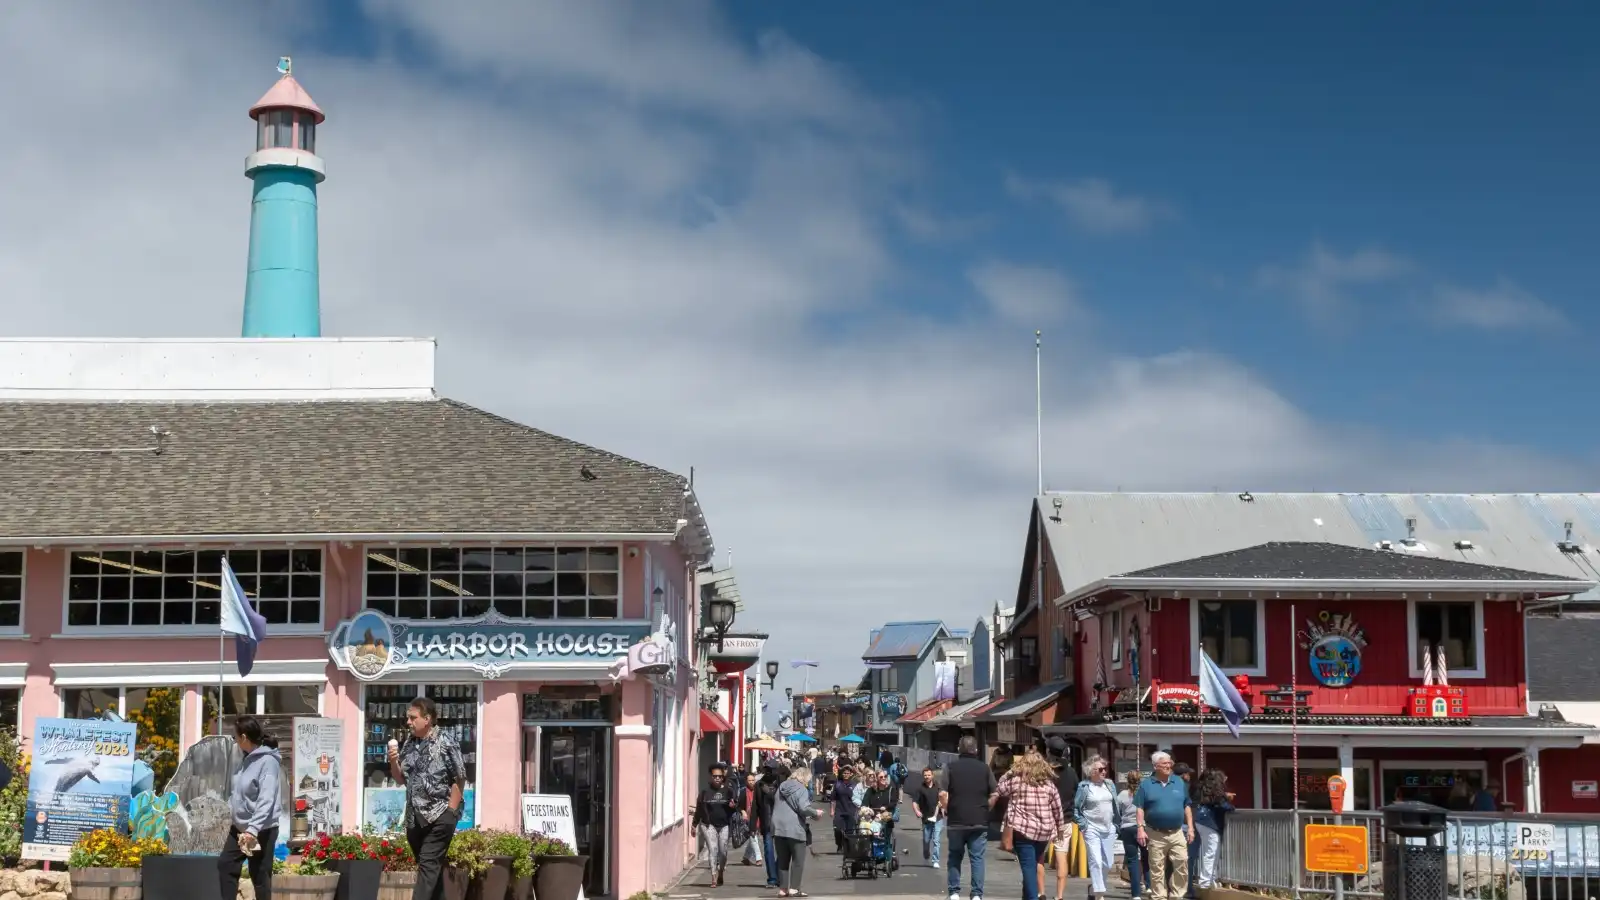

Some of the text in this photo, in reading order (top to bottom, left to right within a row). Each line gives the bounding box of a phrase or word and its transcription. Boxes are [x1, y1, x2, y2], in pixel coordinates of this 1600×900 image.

[405, 631, 631, 658] HARBOR HOUSE
[736, 640, 759, 648] FRONT
[1159, 687, 1199, 697] CANDYWORLD
[40, 726, 131, 743] WHALEFEST
[94, 743, 129, 757] 2026
[526, 804, 570, 818] PEDESTRIANS
[541, 820, 557, 834] ONLY
